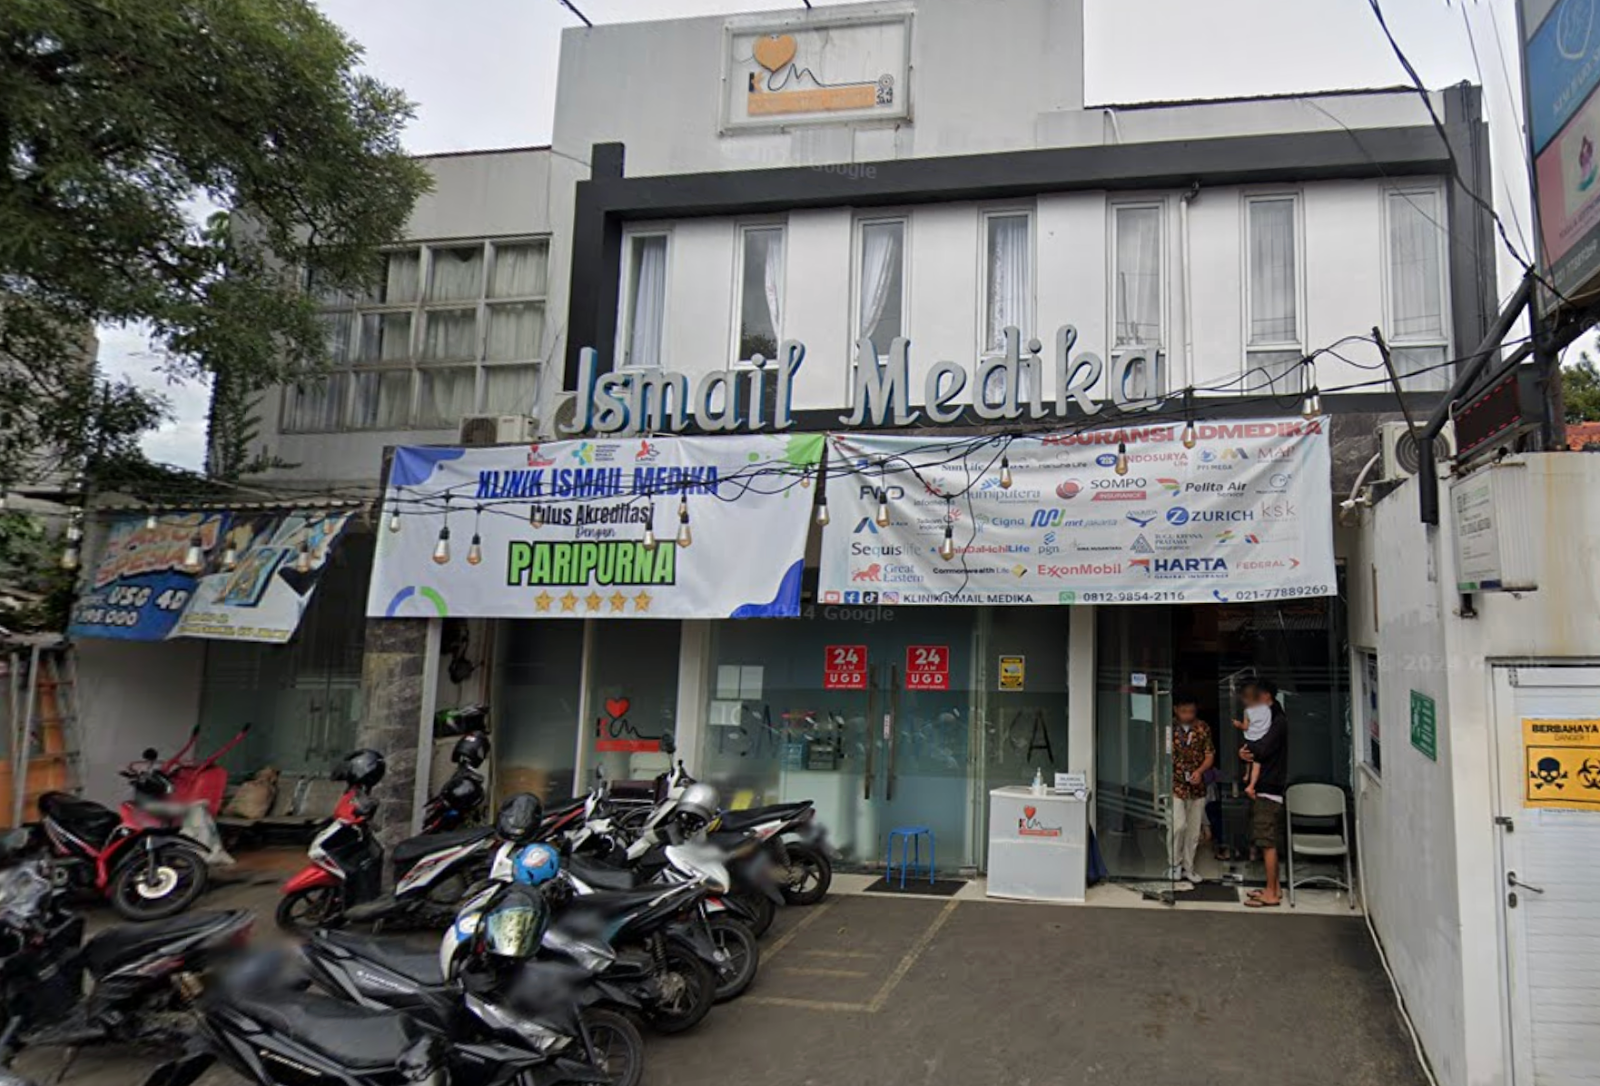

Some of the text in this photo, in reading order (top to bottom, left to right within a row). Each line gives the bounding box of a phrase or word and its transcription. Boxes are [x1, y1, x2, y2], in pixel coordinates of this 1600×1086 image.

[559, 324, 1166, 434] Ismail Medika
[1041, 421, 1323, 446] ASURANSI ADMEDIKA
[1125, 452, 1189, 464] NDOSURYA
[475, 465, 719, 499] KLINIK ISMAIL MEDIKA
[1090, 477, 1147, 489] SOMPO
[1185, 482, 1224, 493] Pelita
[1226, 481, 1248, 492] Air
[575, 502, 655, 526] Akreditasi
[1261, 500, 1297, 518] ksk
[1191, 510, 1254, 522] ZURICH
[992, 517, 1025, 528] Cigna
[1064, 519, 1083, 527] mrt
[1038, 546, 1060, 556] pgn
[507, 540, 677, 586] PARIPURNA
[883, 563, 915, 574] Great
[1154, 558, 1228, 572] HARTA
[1236, 560, 1285, 570] FEDERAL
[1037, 564, 1122, 578] ExxonMobil
[903, 594, 940, 603] KLINIK
[987, 593, 1034, 603] MEDIKA
[1083, 591, 1185, 602] 0812-9854-2116
[1236, 585, 1328, 600] 021-77889269
[833, 648, 859, 665] 24
[914, 648, 941, 665] 24
[829, 673, 861, 683] UGD
[911, 673, 943, 683] UGD
[1532, 724, 1599, 734] BERBAHAYA
